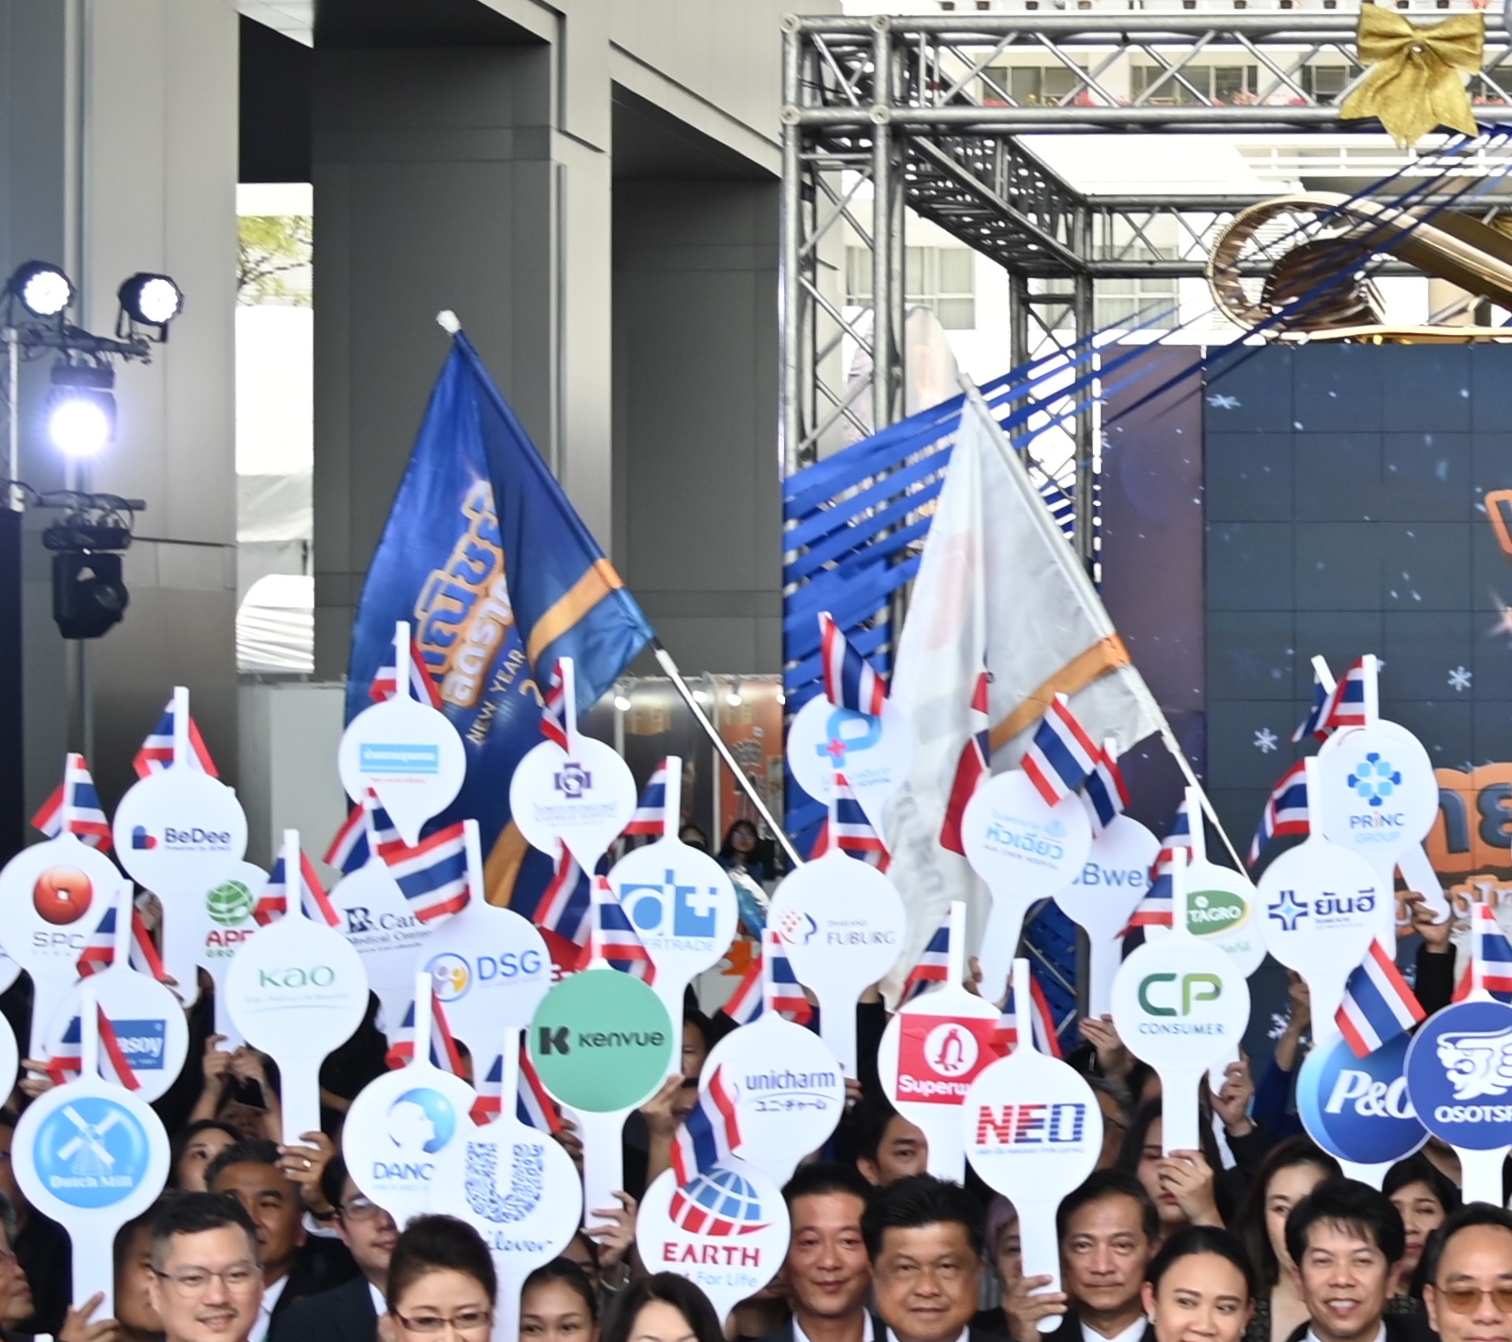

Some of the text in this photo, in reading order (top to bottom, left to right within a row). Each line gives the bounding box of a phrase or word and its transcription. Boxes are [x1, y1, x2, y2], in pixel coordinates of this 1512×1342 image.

[467, 649, 529, 746] NEW YEAR
[164, 827, 232, 845] BeDee
[1314, 886, 1377, 916] ยันฮี
[1188, 905, 1242, 925] TAGRO
[31, 930, 86, 951] SPC
[477, 949, 542, 981] DSG
[1137, 971, 1224, 1017] CP
[1137, 1022, 1226, 1036] CONSUMER
[744, 1069, 836, 1092] unicharm
[975, 1102, 1088, 1146] NEO
[50, 1173, 134, 1190] Dutch Mill
[661, 1241, 762, 1267] EARTH
[723, 1268, 759, 1288] Life
